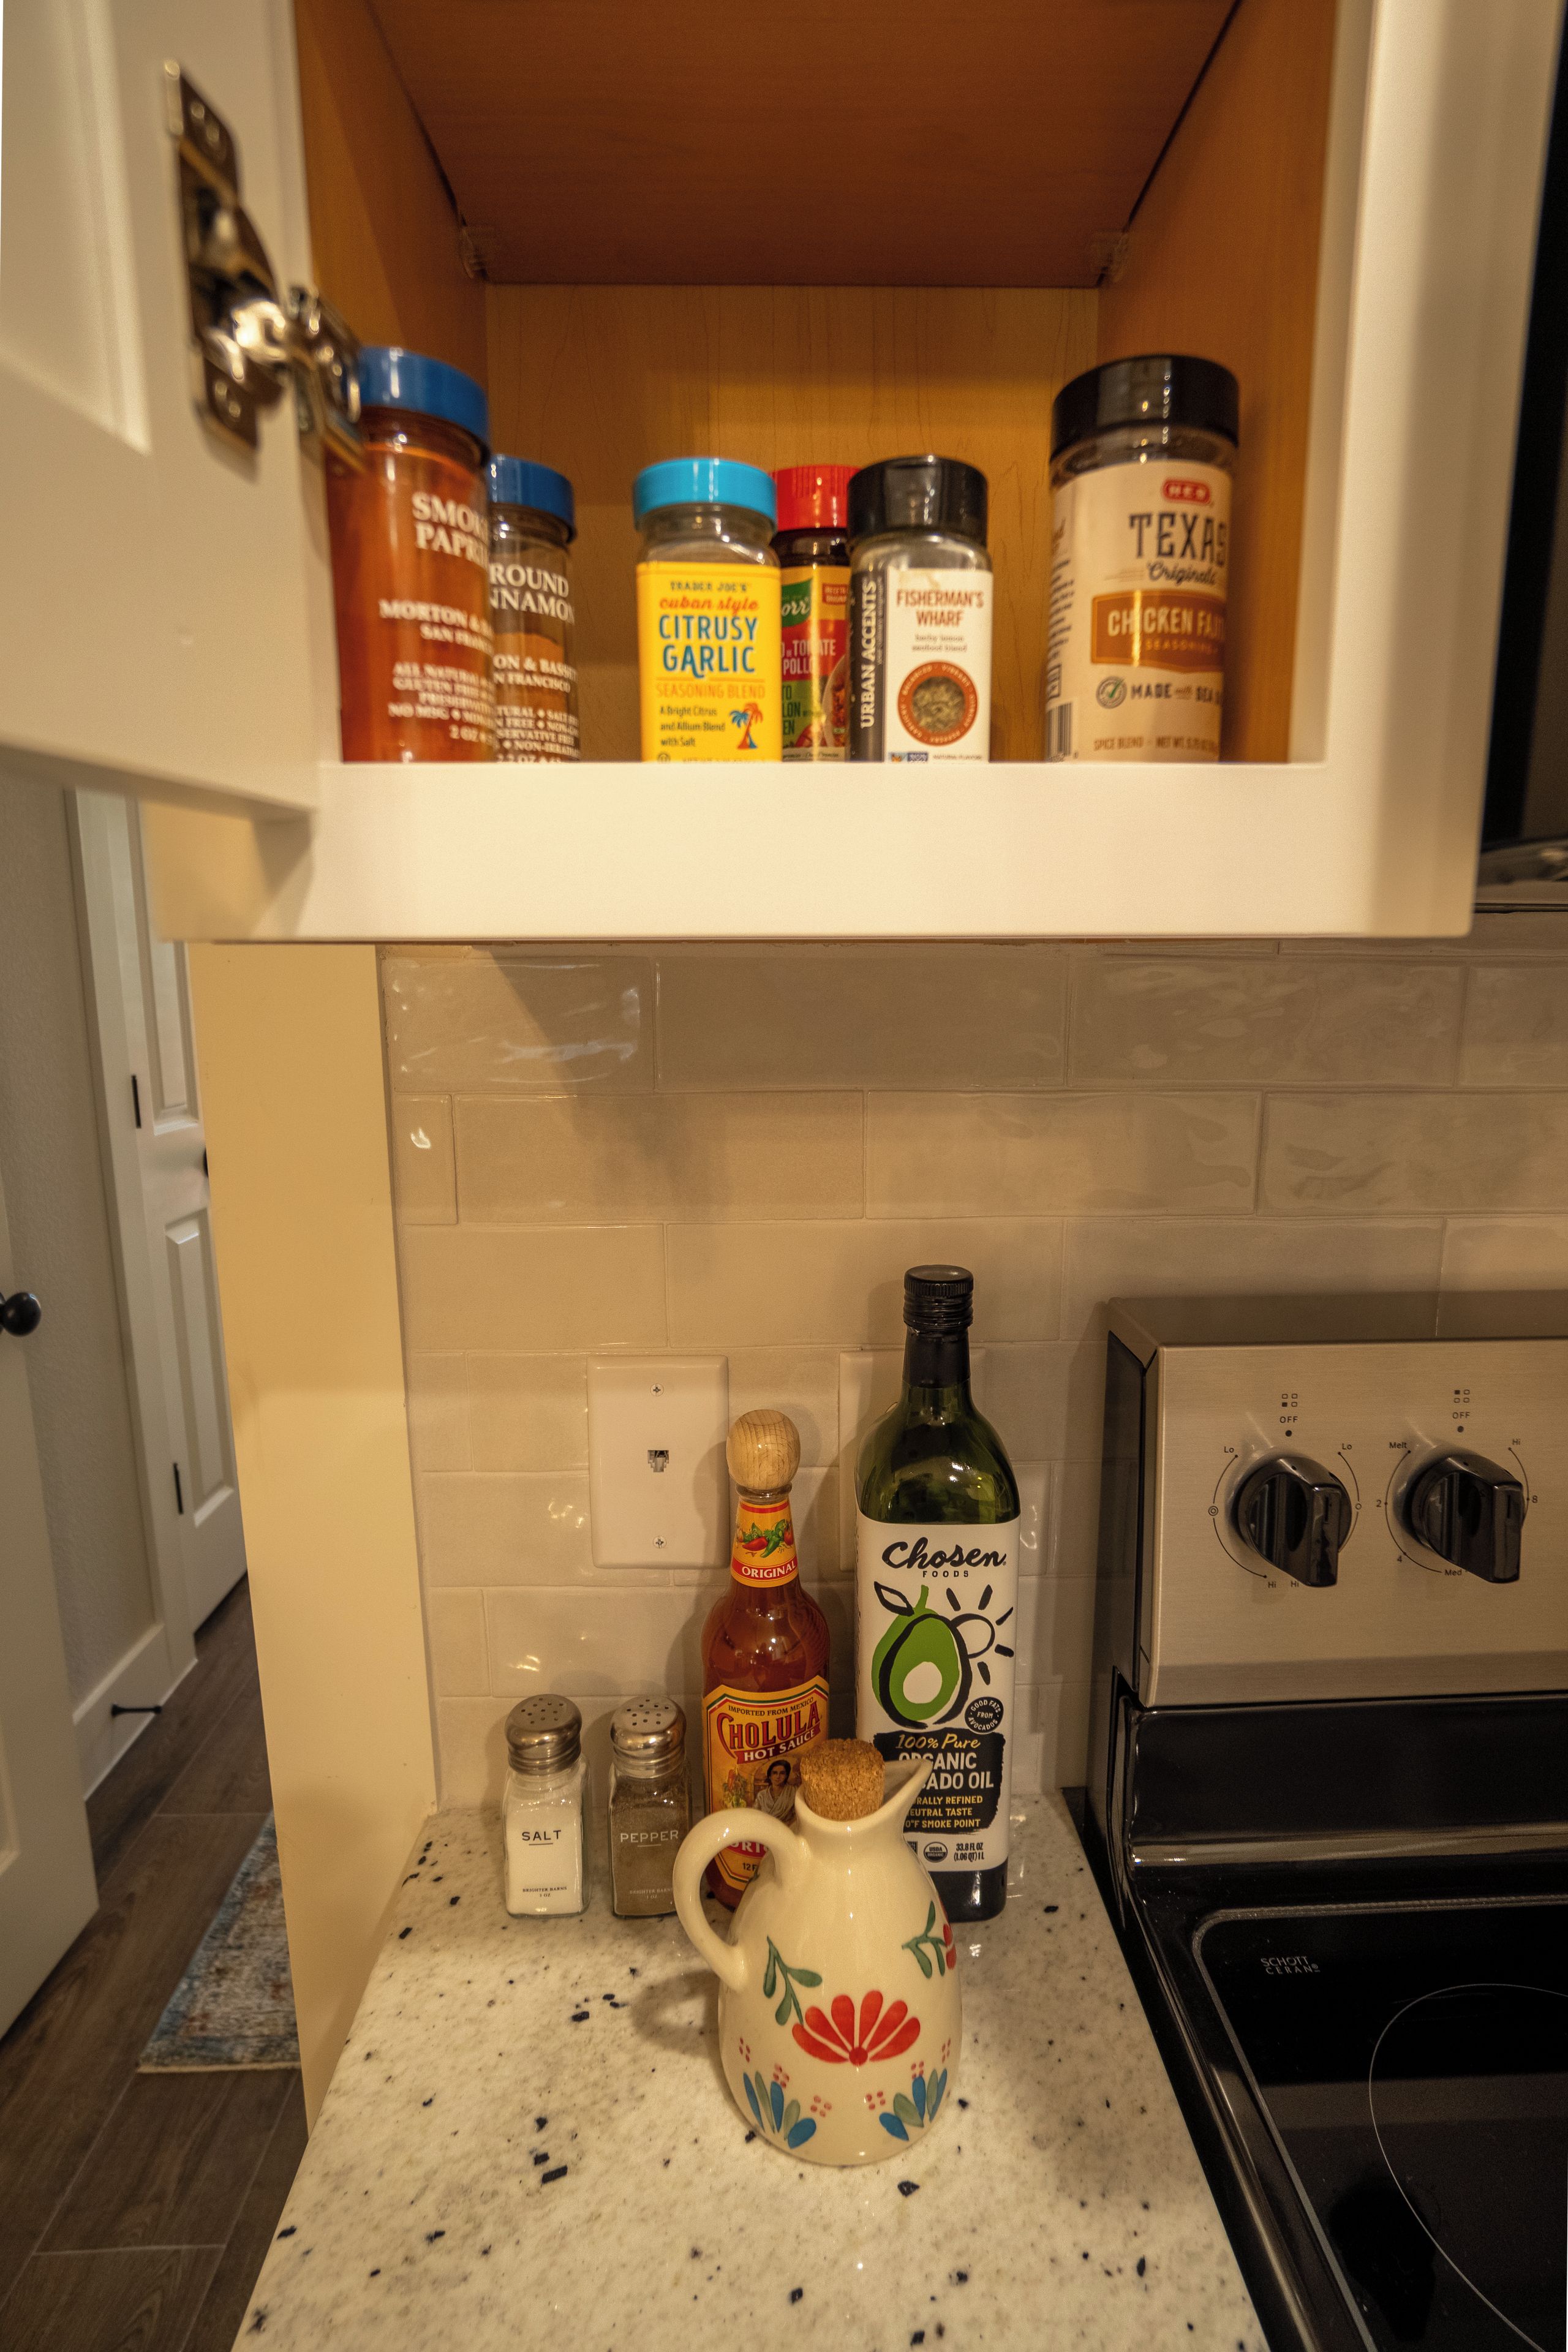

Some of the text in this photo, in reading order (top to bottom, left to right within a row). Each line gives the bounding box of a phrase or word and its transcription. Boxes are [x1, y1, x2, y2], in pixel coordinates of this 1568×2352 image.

[489, 562, 569, 598] ROUND
[670, 581, 747, 592] TRADER JOE'S
[490, 586, 575, 625] NAMON
[659, 595, 758, 616] cuban style
[896, 589, 984, 608] FISHERMAN'S
[782, 601, 810, 615] orr
[916, 609, 964, 627] WHARF
[1107, 606, 1194, 637] CHCKEN
[659, 614, 759, 641] CITRUSY
[663, 645, 755, 679] GARLIC
[860, 581, 876, 729] URBAN ACCENTS
[657, 683, 725, 698] SEASONING
[728, 684, 765, 699] BLEND
[1131, 682, 1172, 699] MADE
[497, 706, 533, 718] TURAL
[661, 722, 674, 731] and
[703, 722, 726, 732] Blend
[497, 728, 557, 743] SERVATIVE
[661, 737, 678, 746] with
[741, 1561, 796, 1578] ORIGINAL
[728, 1705, 765, 1716] IMPORTED
[790, 1697, 814, 1712] MEXICO
[971, 1699, 1001, 1713] GOOD FATS
[716, 1700, 821, 1758] CHOLULA
[968, 1717, 998, 1731] AVOCADOS
[744, 1728, 815, 1762] HOT SAUCE
[895, 1733, 981, 1749] 100% Pure
[968, 1771, 994, 1789] OIL
[916, 1795, 983, 1805] RALLY REFINED
[910, 1807, 973, 1817] EUTRAL TASTE
[922, 1819, 952, 1828] SMOKE
[954, 1819, 981, 1828] POINT
[522, 1830, 562, 1842] SALT
[620, 1830, 679, 1843] PEPPER
[956, 1842, 984, 1852] 33.8 FL OZ
[954, 1852, 967, 1862] (1.06
[968, 1852, 977, 1863] QT)
[981, 1852, 984, 1860] L
[742, 1863, 751, 1871] 12
[1261, 1956, 1309, 1967] SCHOTT
